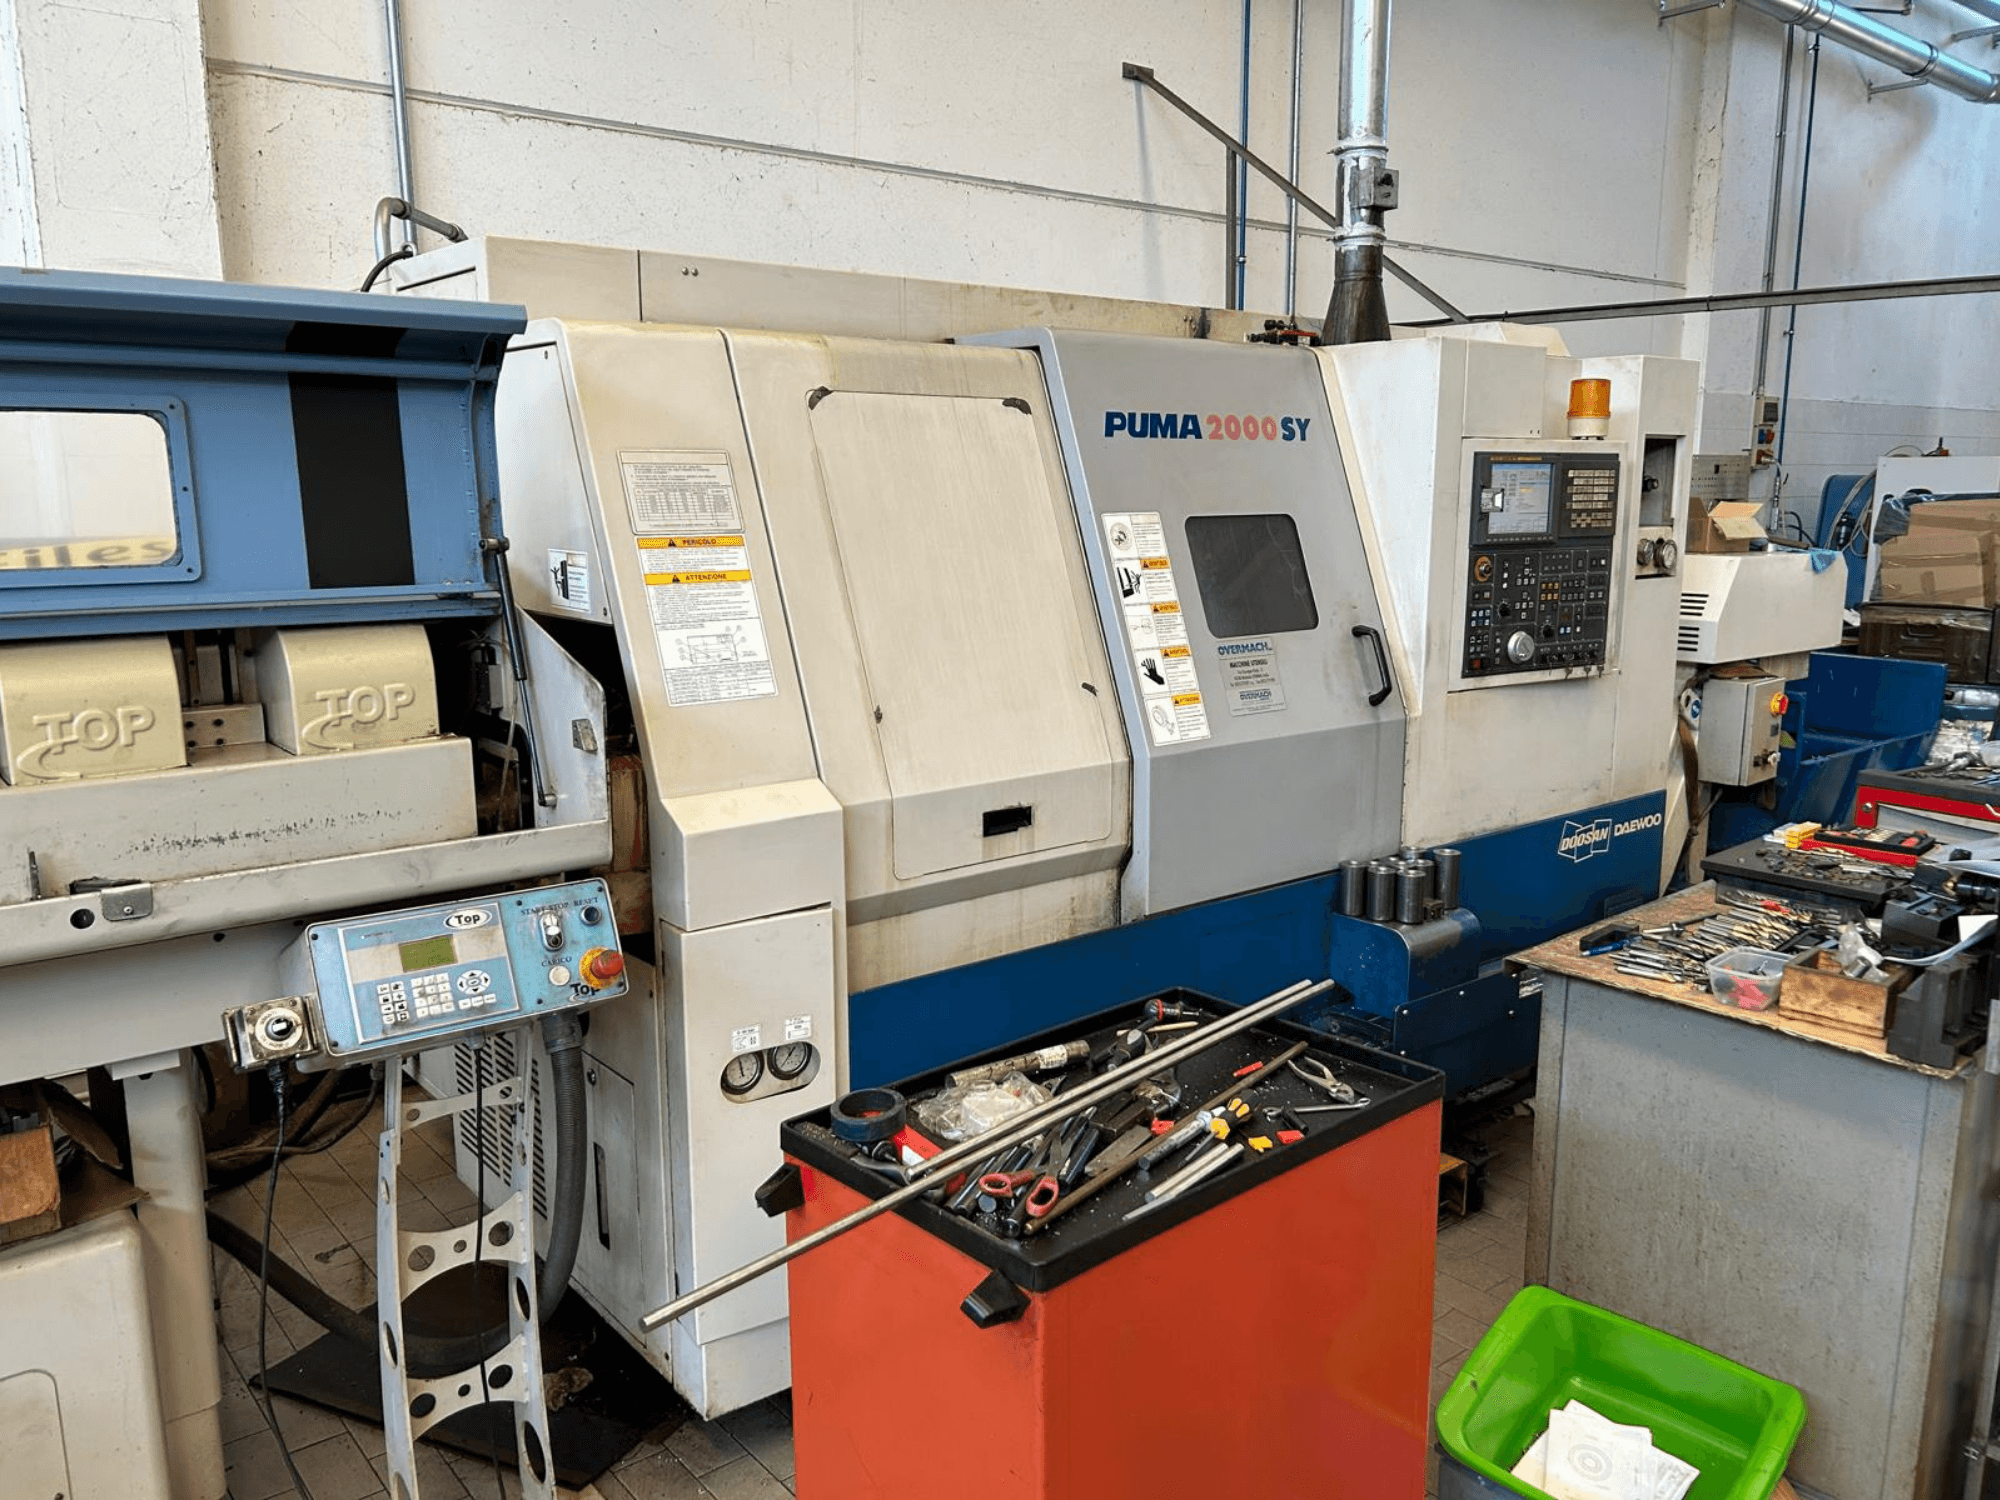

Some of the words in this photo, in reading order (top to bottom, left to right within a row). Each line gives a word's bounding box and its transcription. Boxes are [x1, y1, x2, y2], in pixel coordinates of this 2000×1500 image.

[1105, 411, 1202, 439] PUMA
[1218, 642, 1268, 655] OVERMACH
[315, 683, 415, 727] TOP
[33, 704, 155, 754] TOP
[1559, 826, 1609, 851] DOOSAN
[1614, 813, 1661, 836] DAEWOO
[542, 956, 572, 967] CARICO
